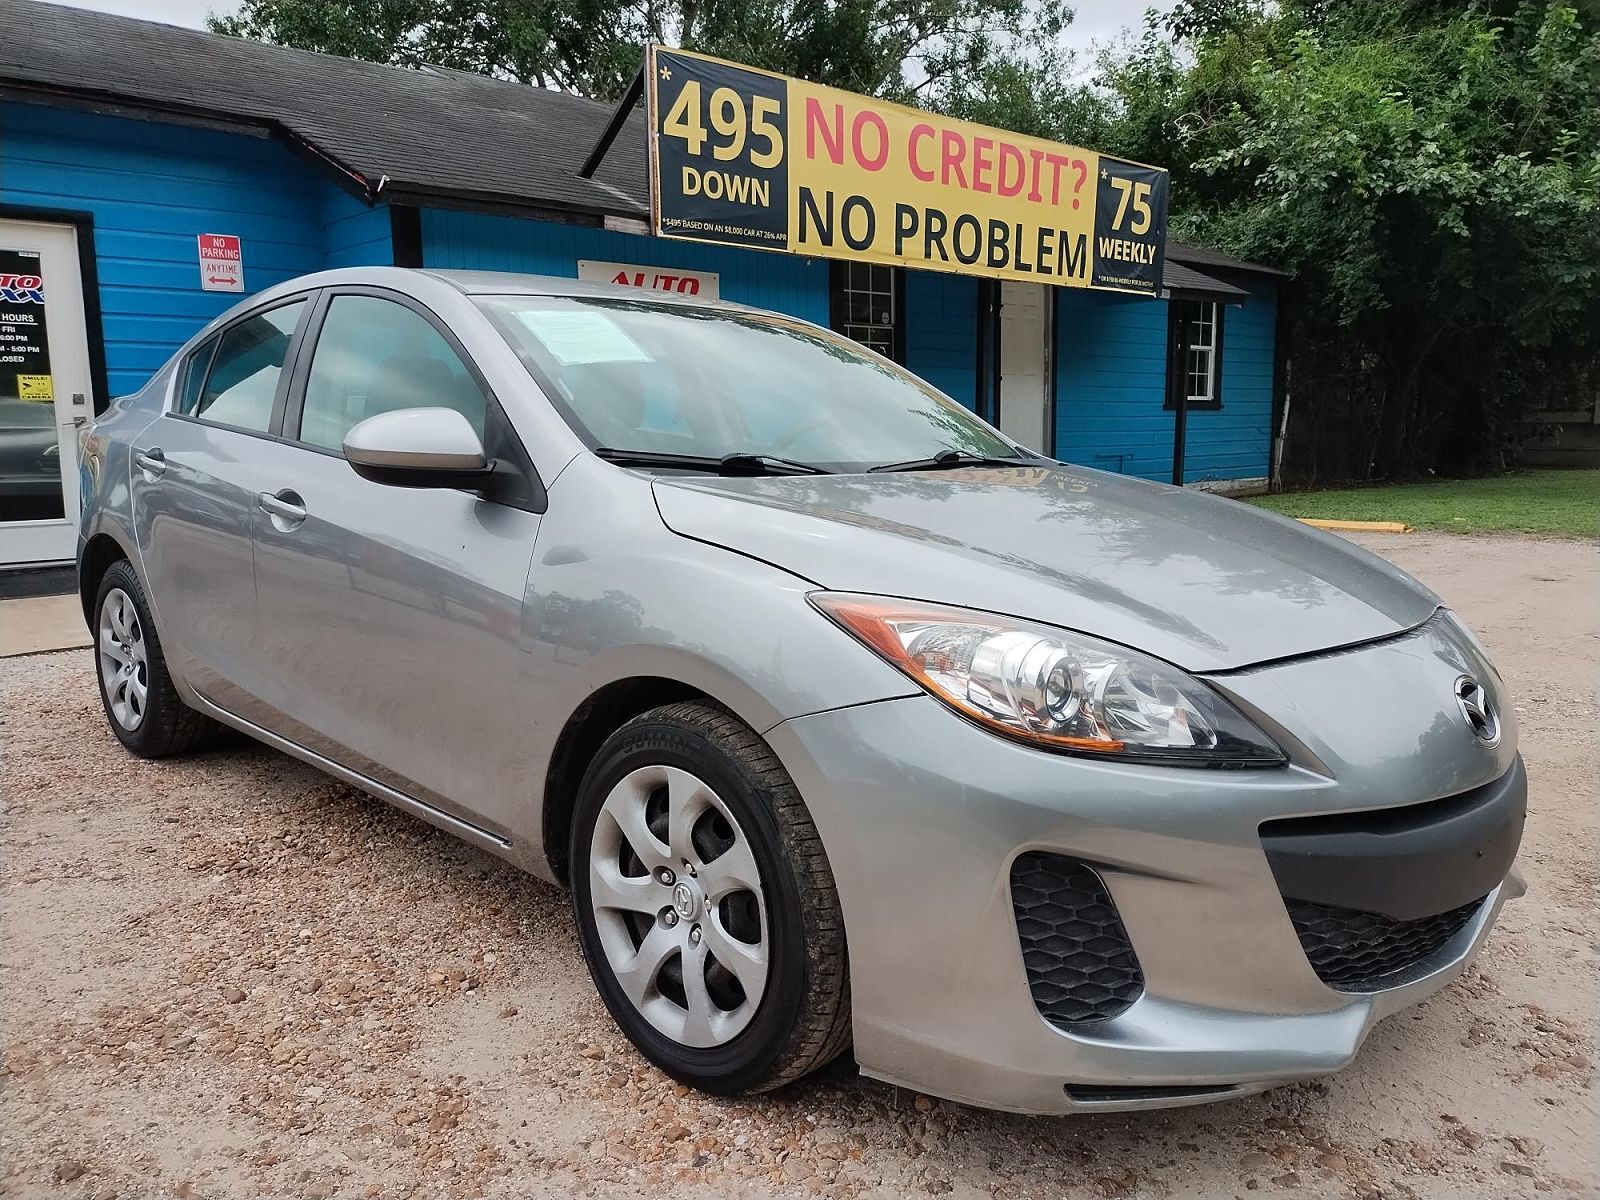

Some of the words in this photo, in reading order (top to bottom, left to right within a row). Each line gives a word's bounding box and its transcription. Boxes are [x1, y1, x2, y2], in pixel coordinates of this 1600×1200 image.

[805, 97, 889, 172] NO
[907, 124, 1088, 210] CREDIT?
[682, 166, 770, 207] DOWN
[682, 220, 703, 230] BASED
[703, 223, 714, 231] ON
[714, 224, 724, 233] AN
[743, 228, 755, 237] CAR
[755, 230, 763, 238] AT
[775, 233, 787, 241] APR
[798, 186, 876, 251] NO
[894, 203, 1088, 280] PROBLEM
[213, 238, 225, 248] NO
[1098, 237, 1156, 265] WEEKLY
[201, 247, 239, 259] PARKING
[207, 264, 238, 274] ANYTIME
[1, 313, 34, 322] HOURS
[2, 325, 16, 333] FRI
